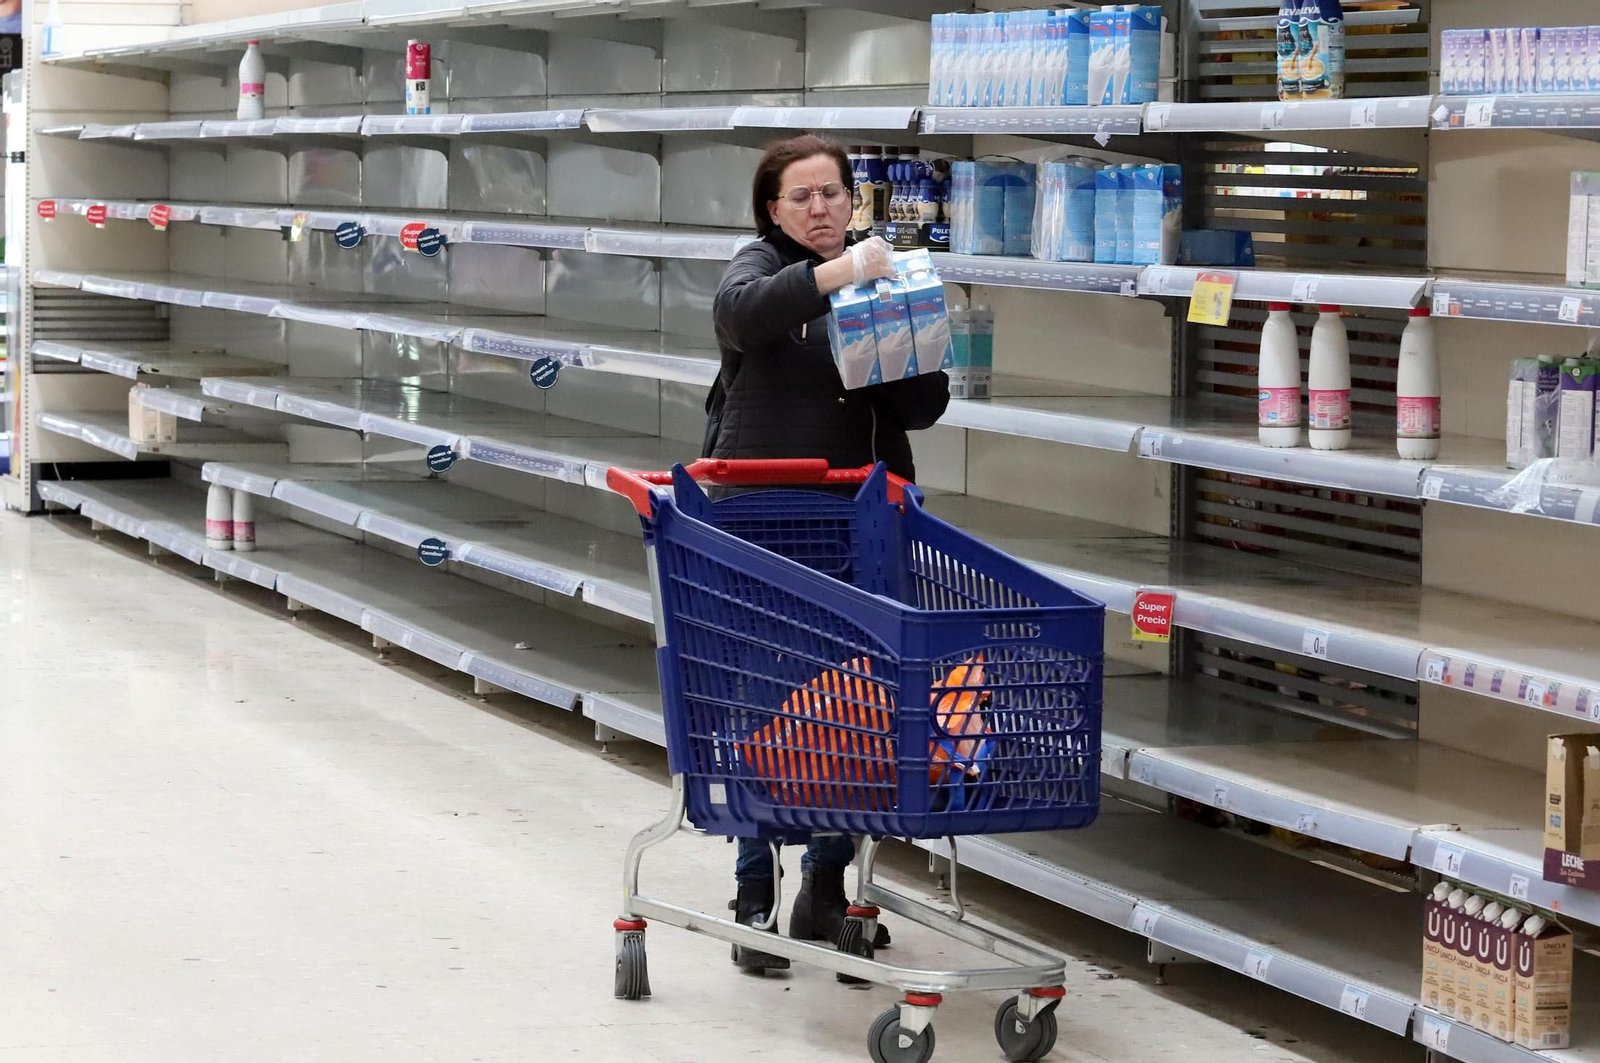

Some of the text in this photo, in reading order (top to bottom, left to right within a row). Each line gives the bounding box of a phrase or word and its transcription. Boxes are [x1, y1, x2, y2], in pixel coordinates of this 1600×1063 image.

[1138, 601, 1167, 612] Super
[1137, 613, 1167, 625] Precio
[1561, 852, 1584, 872] LECHE
